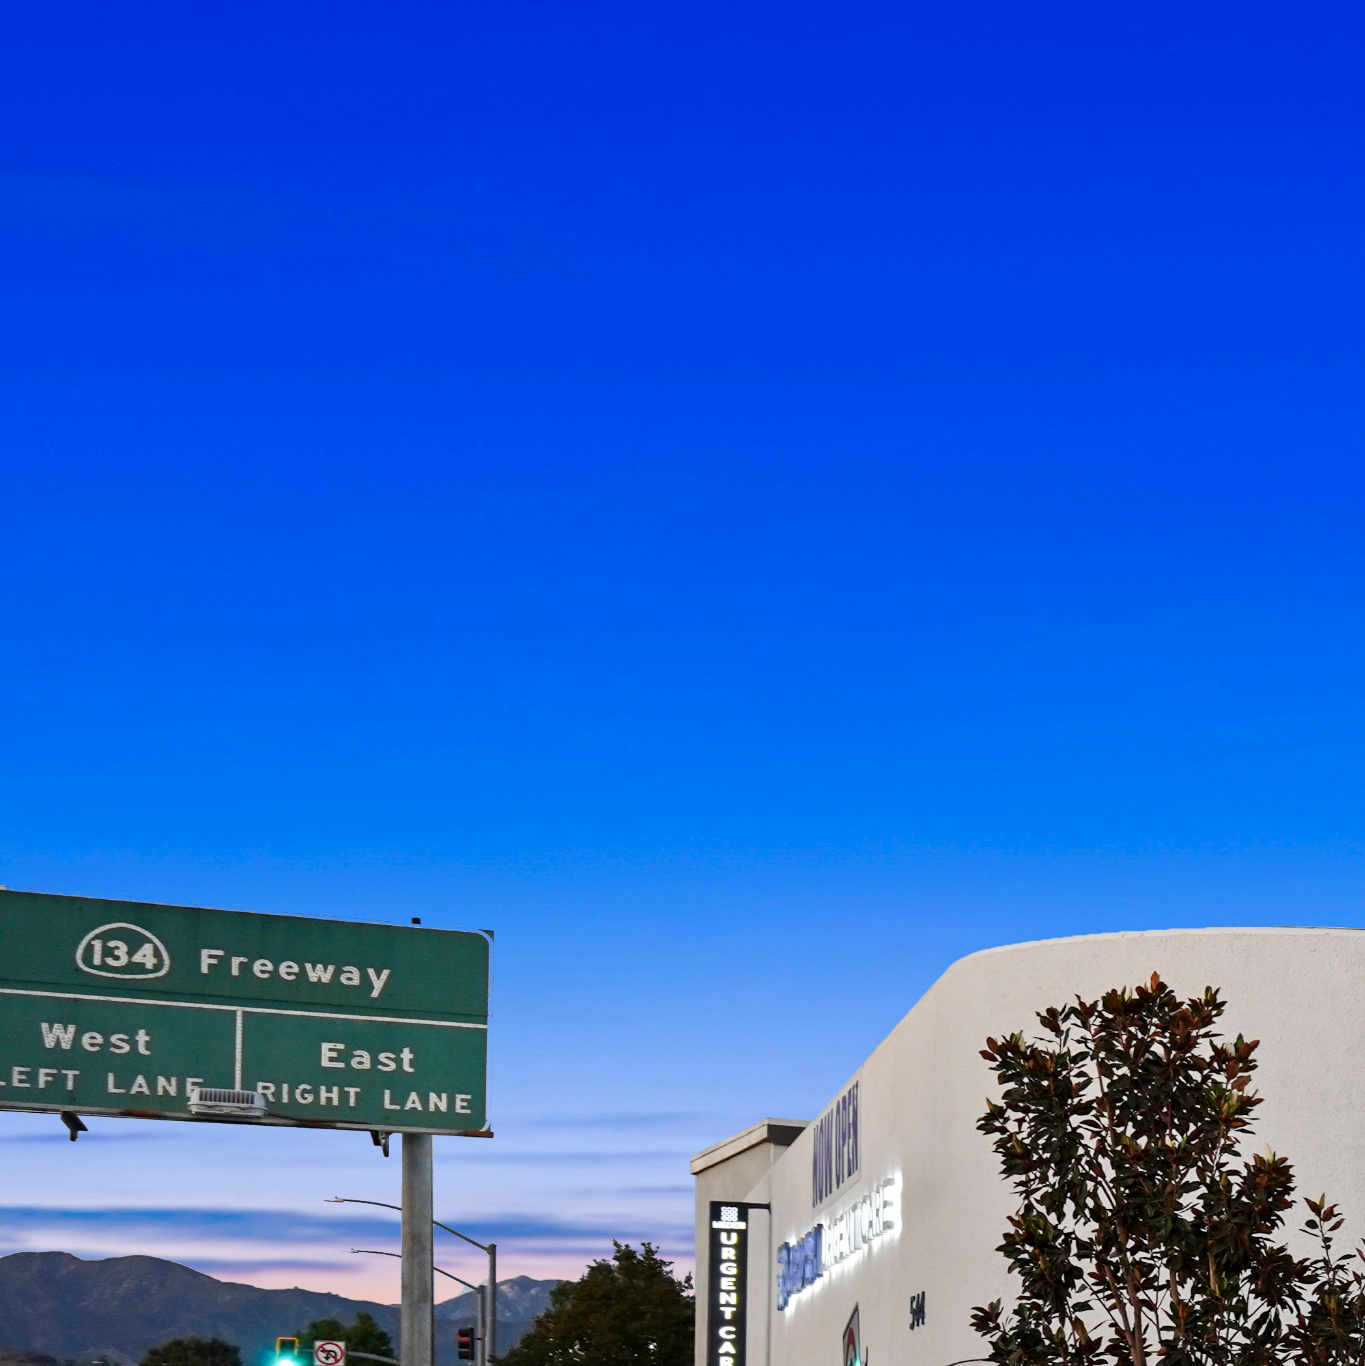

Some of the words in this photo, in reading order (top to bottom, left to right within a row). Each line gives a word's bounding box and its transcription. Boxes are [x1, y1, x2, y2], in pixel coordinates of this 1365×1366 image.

[90, 939, 158, 970] 134
[200, 948, 391, 998] Freeway
[41, 1022, 152, 1056] West
[321, 1041, 415, 1074] East
[0, 1066, 80, 1091] EFT
[107, 1073, 204, 1099] LANE
[257, 1081, 361, 1107] RIGHT
[383, 1089, 473, 1115] LANE
[812, 1107, 835, 1209] NOW
[834, 1080, 859, 1190] OPEN
[719, 1231, 739, 1320] URGENT
